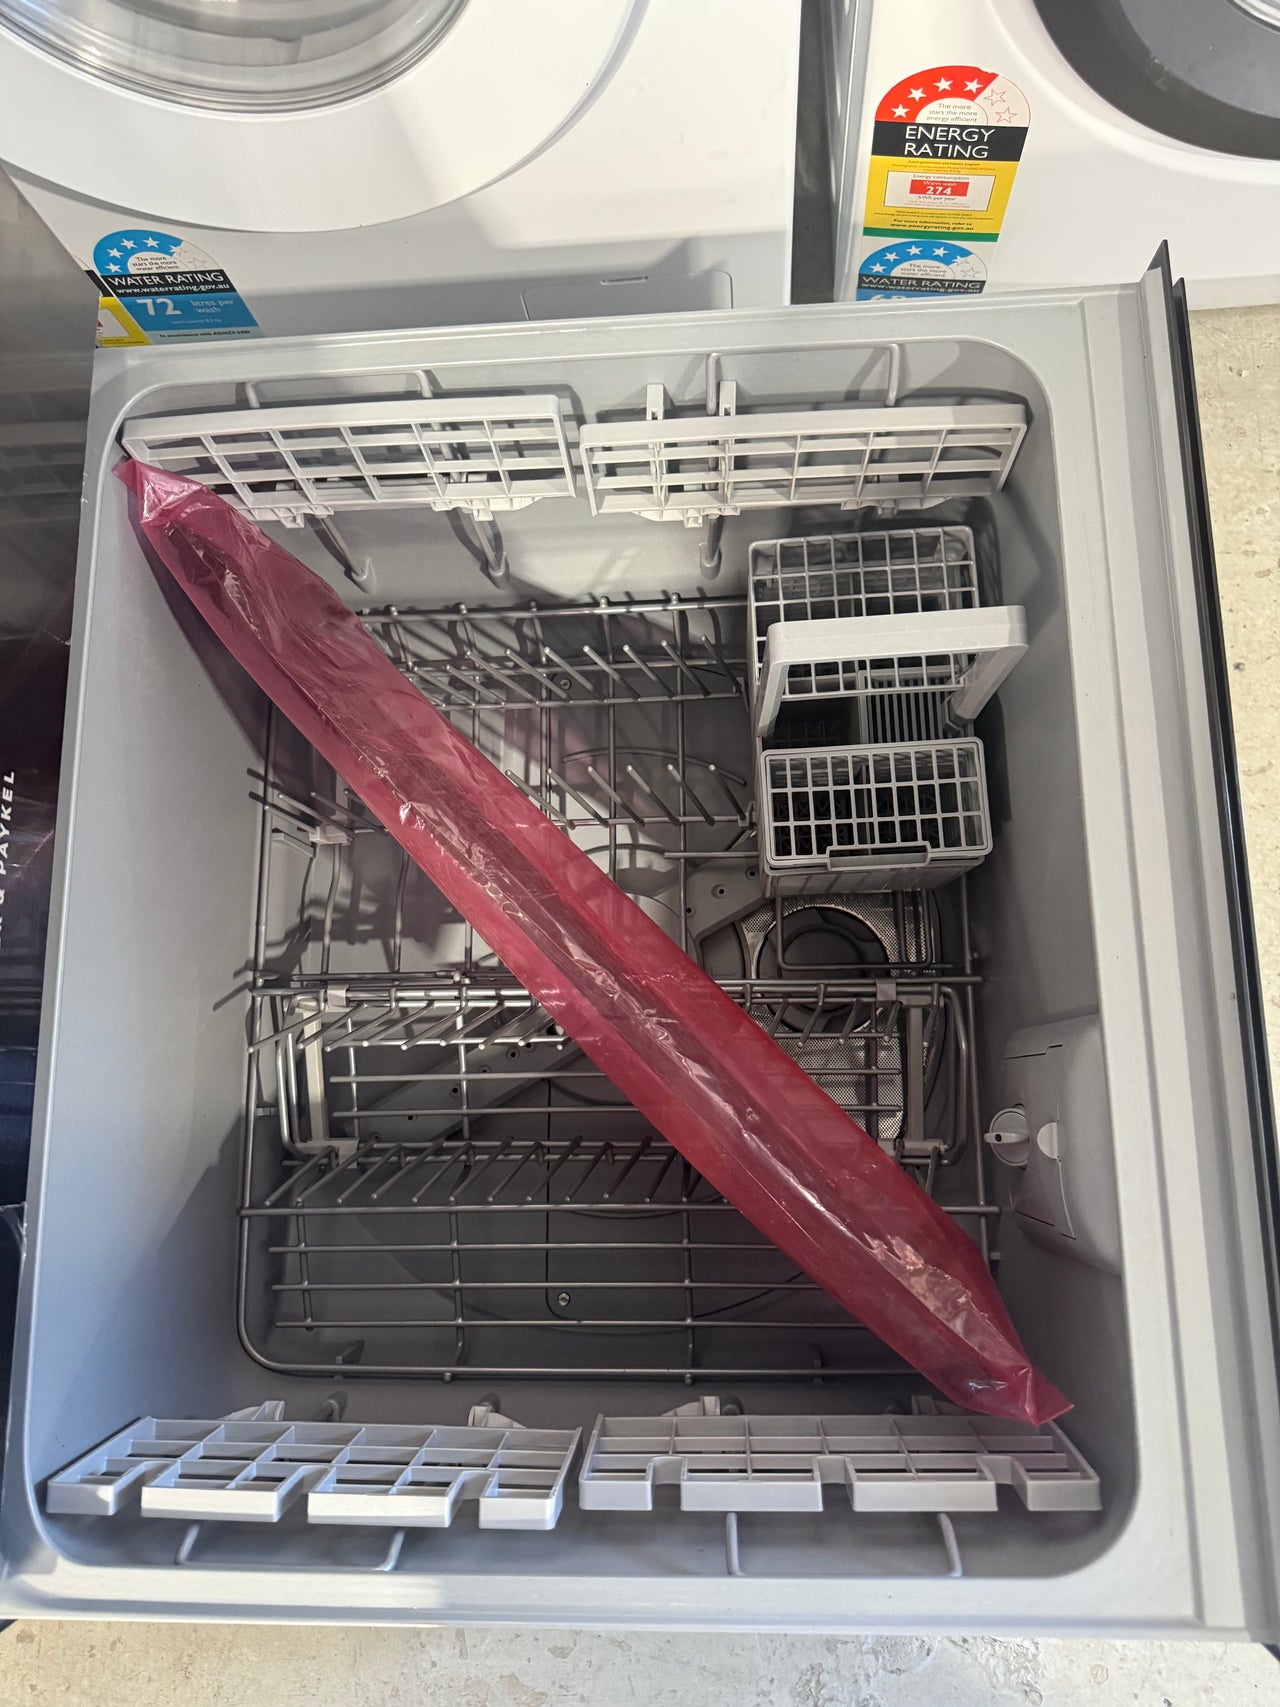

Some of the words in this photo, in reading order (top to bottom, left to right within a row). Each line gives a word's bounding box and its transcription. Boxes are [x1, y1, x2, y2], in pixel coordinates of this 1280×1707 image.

[937, 102, 951, 110] The
[905, 125, 996, 143] ENERGY
[903, 142, 990, 159] RATING
[926, 186, 952, 195] 274
[107, 274, 165, 287] WATER
[165, 272, 225, 284] RATING
[861, 276, 918, 287] WATER
[920, 279, 981, 289] RATING
[115, 283, 231, 294] www.waterrating.gov.au
[136, 298, 183, 316] 72
[0, 771, 15, 876] PAYKEL
